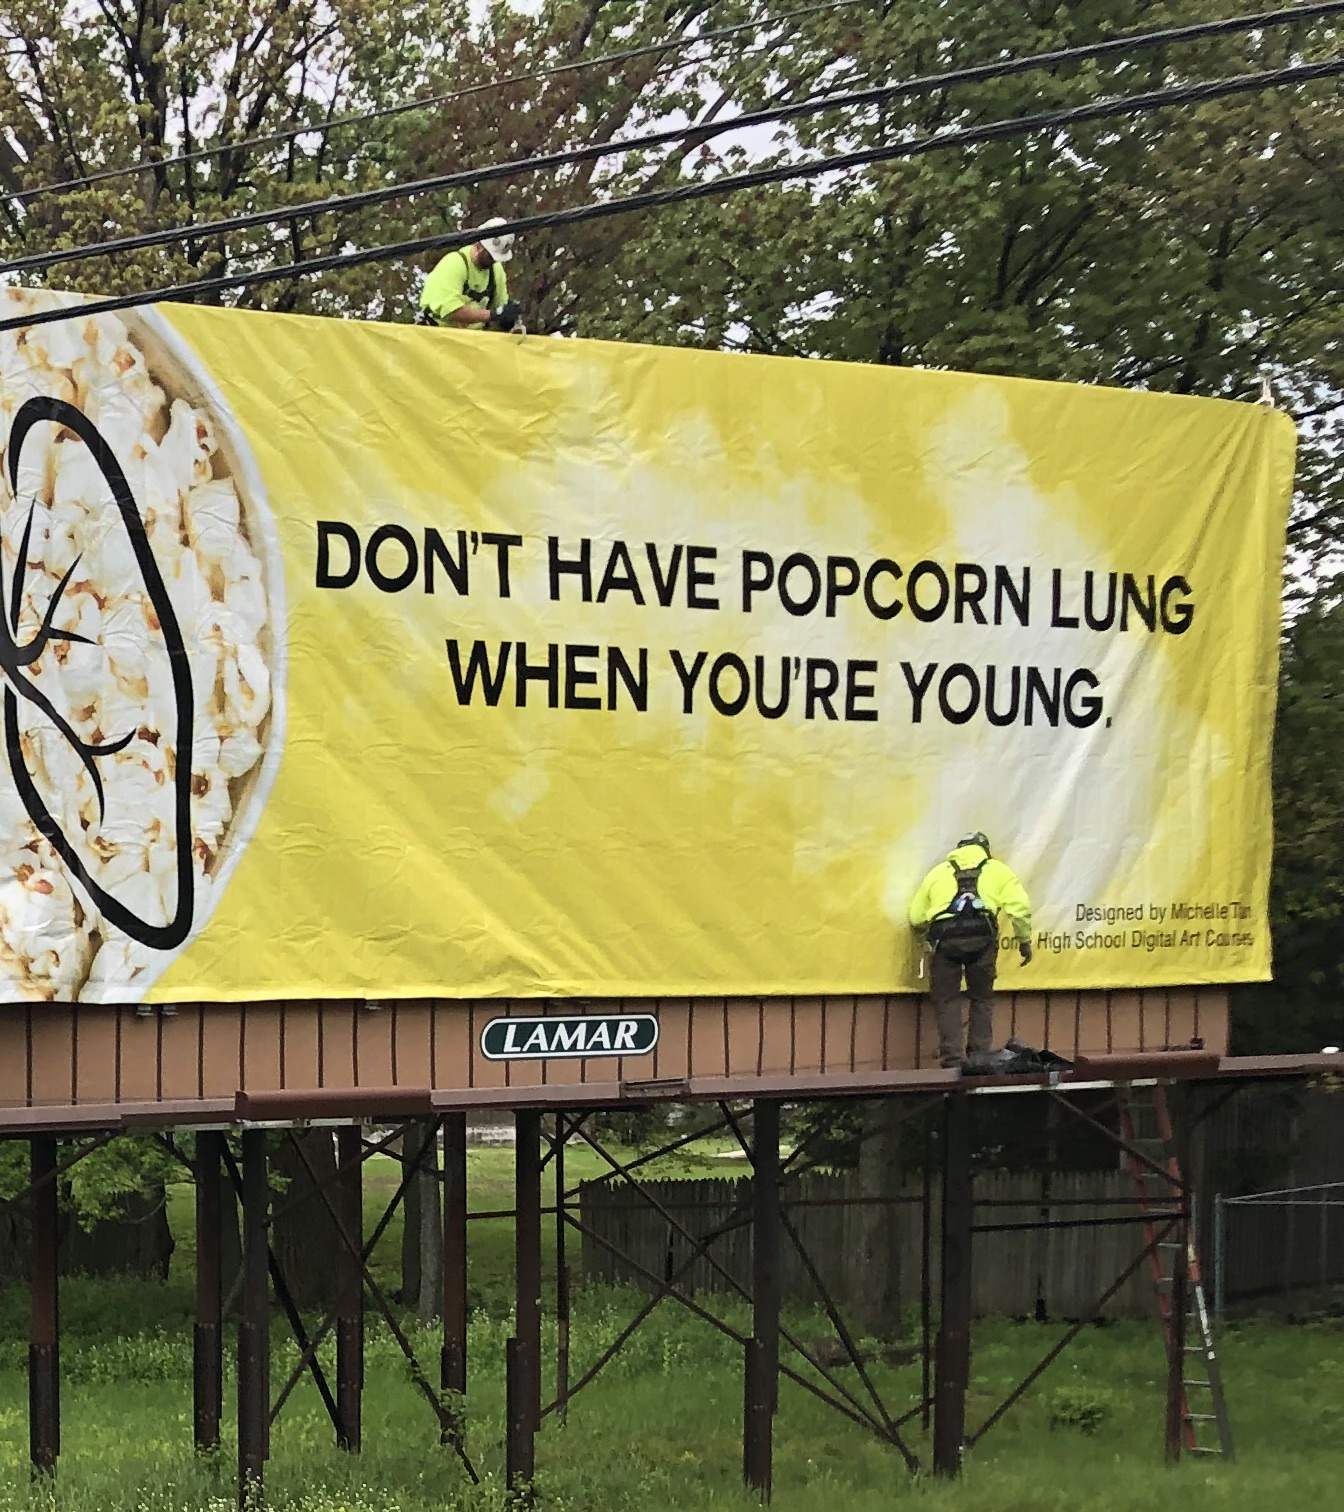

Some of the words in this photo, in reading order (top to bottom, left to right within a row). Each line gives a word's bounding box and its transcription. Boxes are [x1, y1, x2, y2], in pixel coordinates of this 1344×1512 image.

[315, 520, 523, 598] DON'T
[548, 535, 720, 610] HAVE
[742, 550, 1031, 627] POPCORN
[1051, 568, 1196, 635] LUNG
[445, 639, 648, 712] WHEN
[669, 649, 879, 722] YOU'RE
[900, 661, 1113, 729] YOUNG.
[1075, 903, 1143, 926] Designed
[1149, 903, 1167, 925] by
[1171, 902, 1229, 920] Michelle
[1037, 931, 1071, 954] High
[1075, 930, 1126, 950] School
[1132, 929, 1177, 953] Digital
[1180, 928, 1200, 947] Art
[502, 1020, 639, 1053] LAMAR
